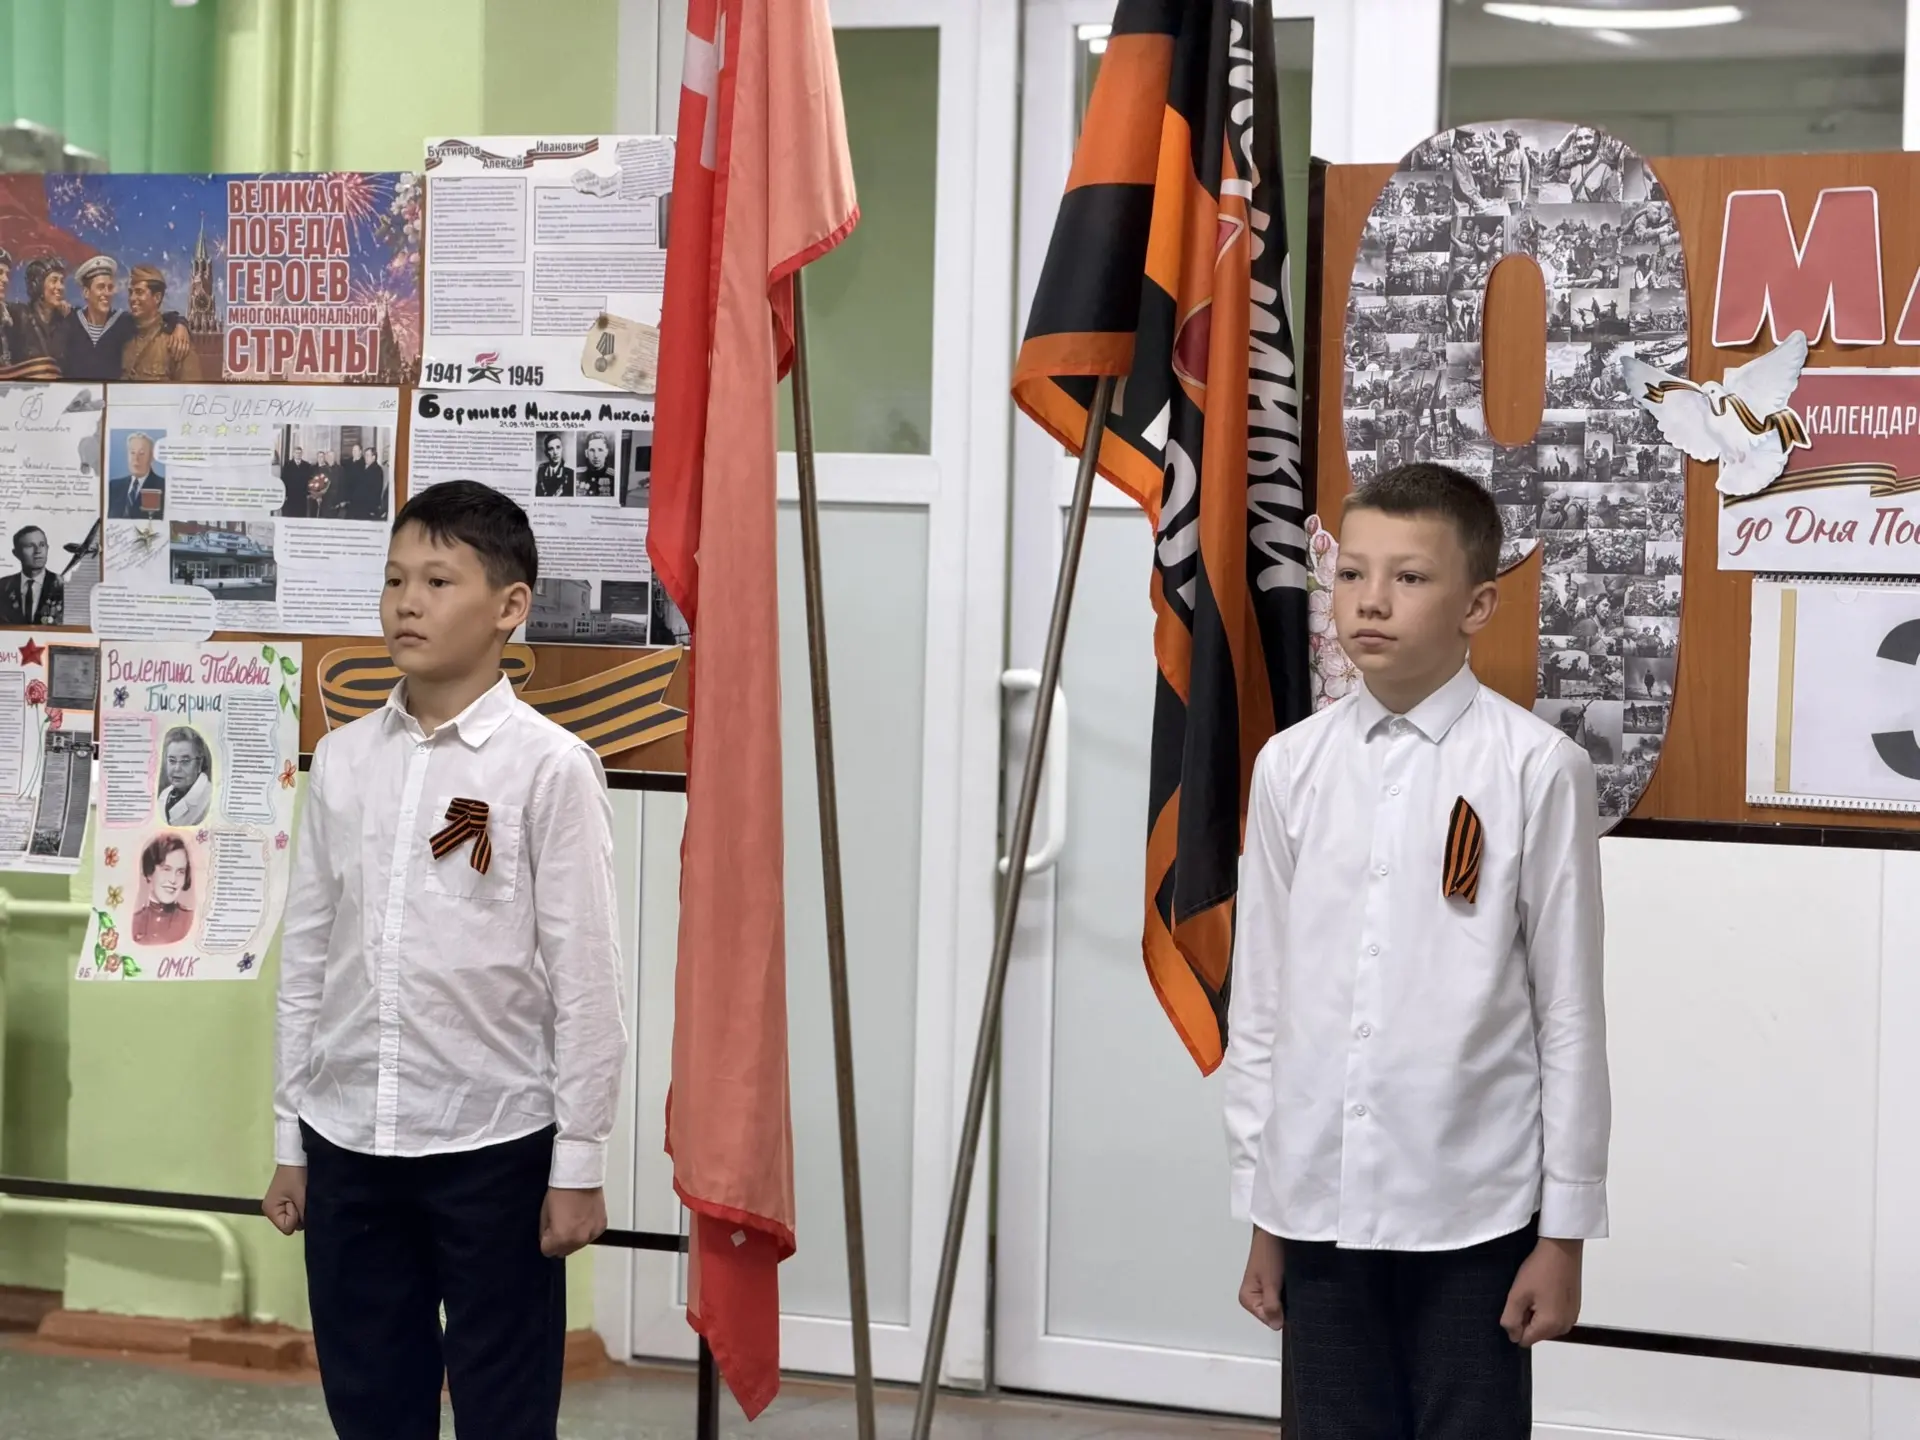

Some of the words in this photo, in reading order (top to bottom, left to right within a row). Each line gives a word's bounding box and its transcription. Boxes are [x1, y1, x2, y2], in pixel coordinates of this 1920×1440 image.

[427, 145, 481, 158] Бухтияров
[482, 155, 524, 169] Алексей
[536, 140, 585, 152] Иванович
[227, 180, 344, 215] ВЕЛИКАЯ
[227, 216, 350, 260] ПОБЕДА
[227, 259, 350, 304] ГЕРОЕВ
[1711, 186, 1920, 347] М
[227, 305, 378, 326] МНОГОНАЦИОНАЛЬНОЙ
[226, 326, 380, 376] СТРАНЫ
[425, 363, 462, 384] 1941
[507, 365, 544, 387] 1945
[525, 402, 592, 422] Михаил
[1805, 405, 1920, 440] КАЛЕНДАР
[1728, 516, 1773, 556] до
[1785, 505, 1859, 545] Дня
[1867, 507, 1920, 547] По
[107, 649, 195, 683] Валентина
[200, 652, 271, 686] Павловна
[145, 684, 222, 724] Бисярина
[157, 956, 201, 978] ОМСК
